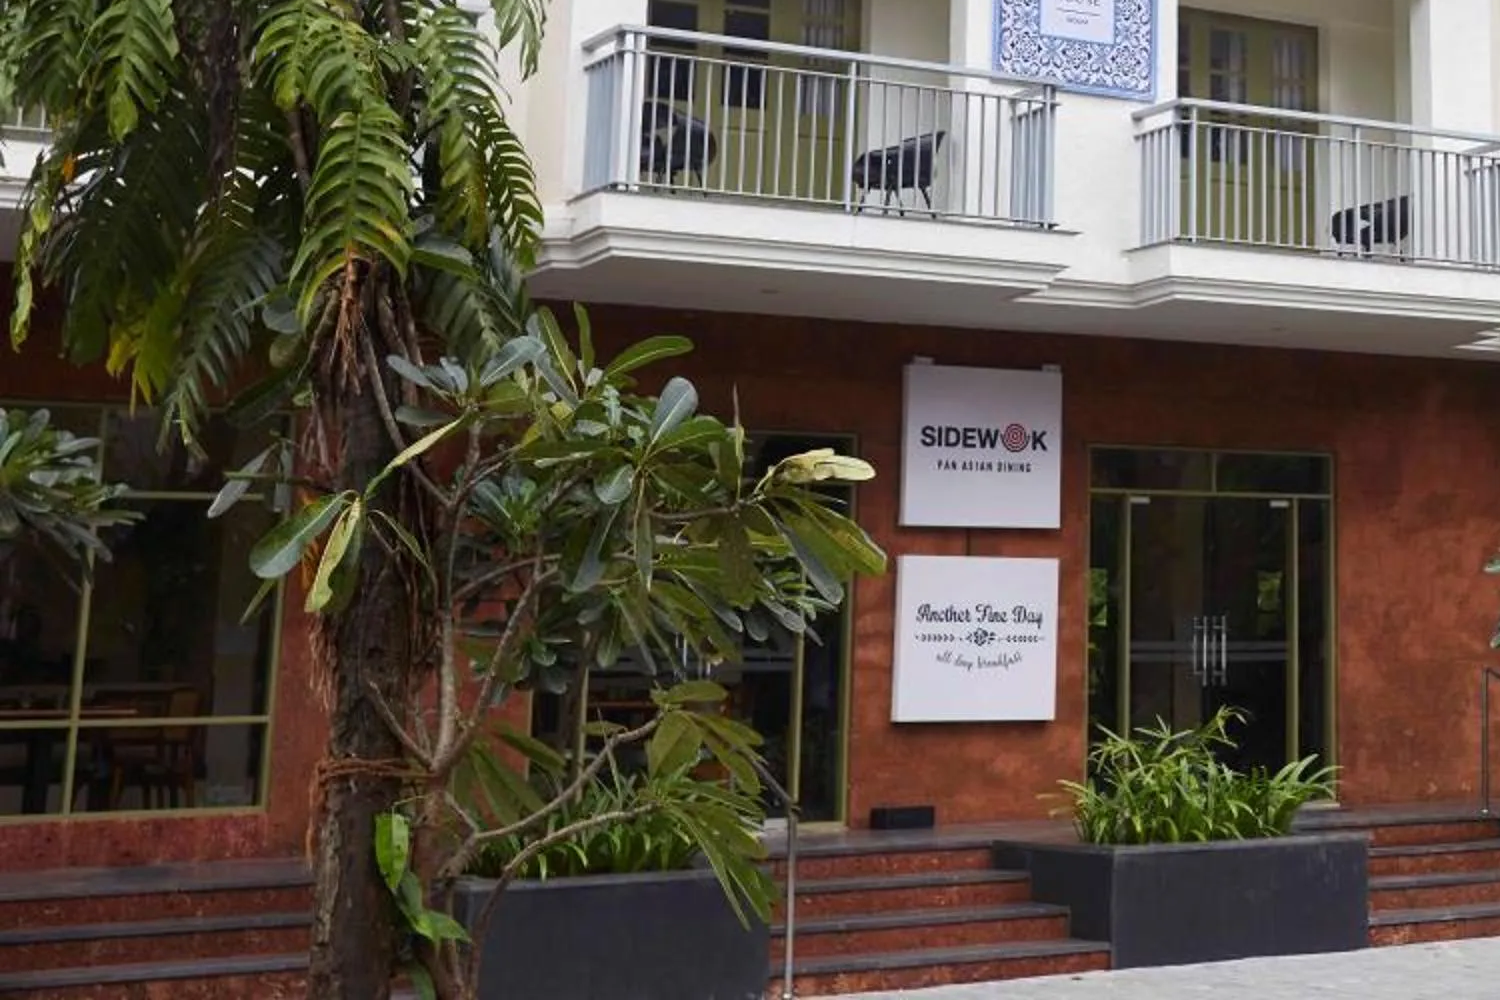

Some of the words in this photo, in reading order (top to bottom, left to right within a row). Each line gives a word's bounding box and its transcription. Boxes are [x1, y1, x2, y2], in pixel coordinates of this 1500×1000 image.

[937, 459, 957, 470] PAN
[962, 460, 992, 472] ASIAN
[997, 461, 1031, 473] DINING
[915, 603, 971, 623] Another
[975, 604, 1008, 623] Fine
[1012, 605, 1043, 629] Day
[977, 651, 1023, 671] breakfast
